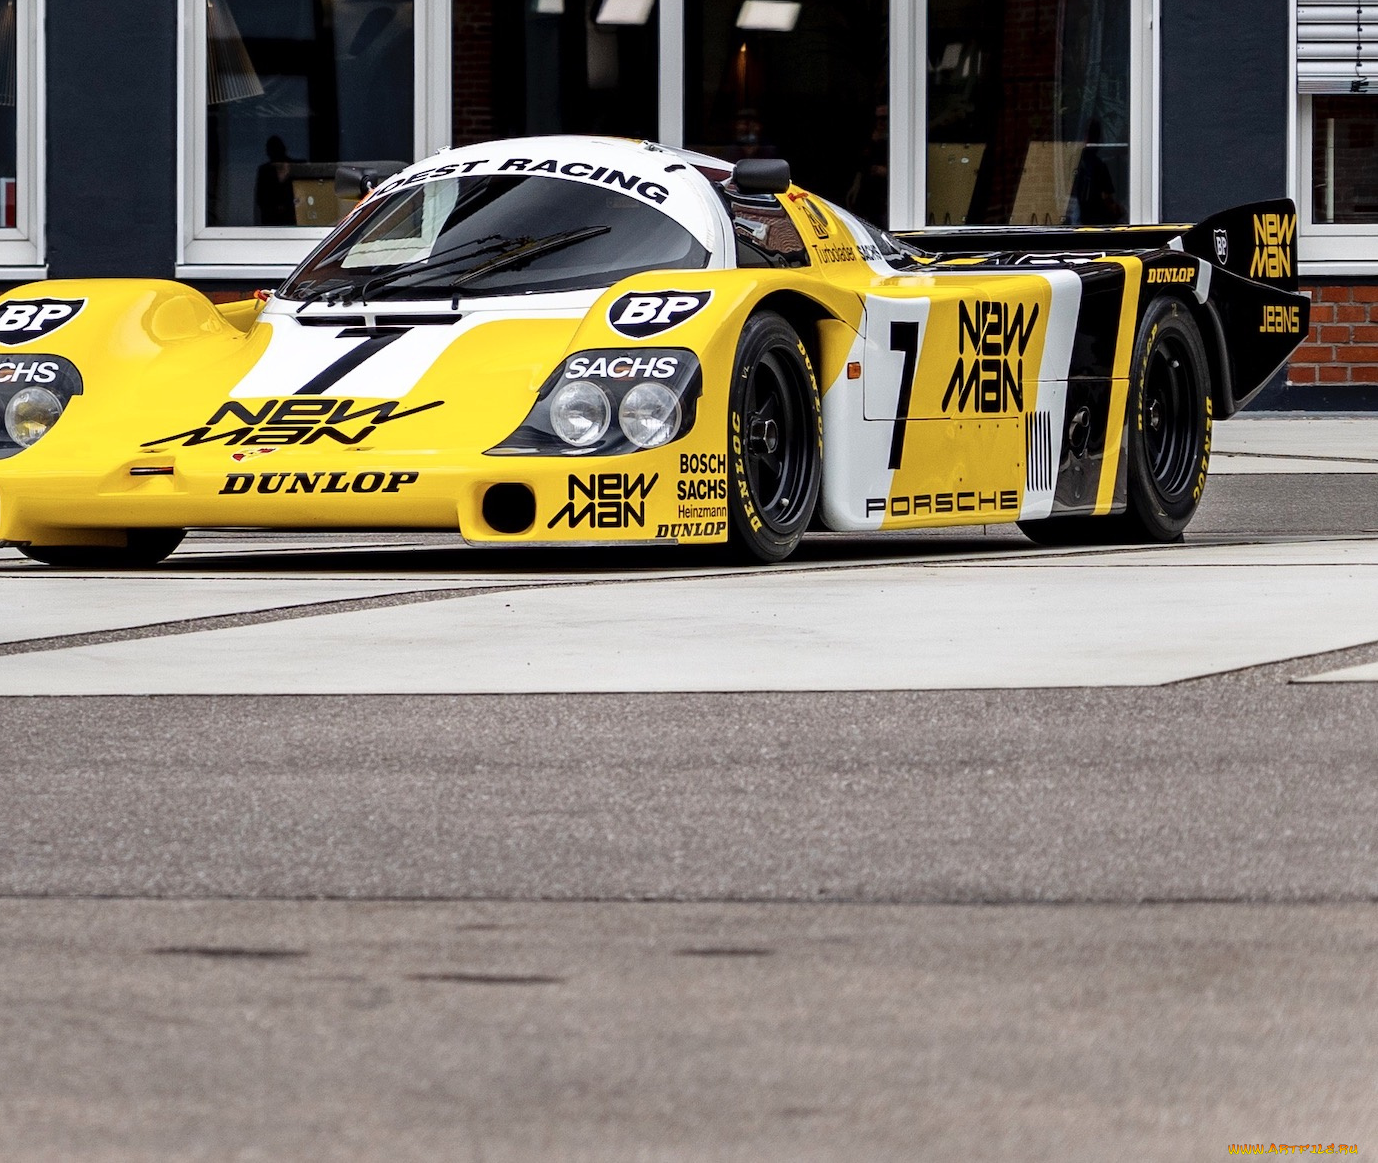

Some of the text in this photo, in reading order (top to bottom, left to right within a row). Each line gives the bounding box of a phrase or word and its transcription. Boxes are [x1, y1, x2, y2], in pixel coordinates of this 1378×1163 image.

[497, 158, 670, 205] RACING
[811, 243, 857, 264] Turbolader
[1215, 236, 1227, 256] BP
[1147, 268, 1195, 283] DUNLOP
[613, 296, 700, 324] BP
[292, 326, 415, 396] 7
[565, 357, 678, 379] SACHS
[887, 321, 919, 470] 7
[680, 454, 726, 473] BOSCH
[218, 472, 419, 494] DUNLOP
[677, 479, 726, 500] SACHS
[678, 505, 726, 518] Heinzmann
[866, 490, 1018, 518] PORSCHE
[655, 522, 726, 537] DUNLOP
